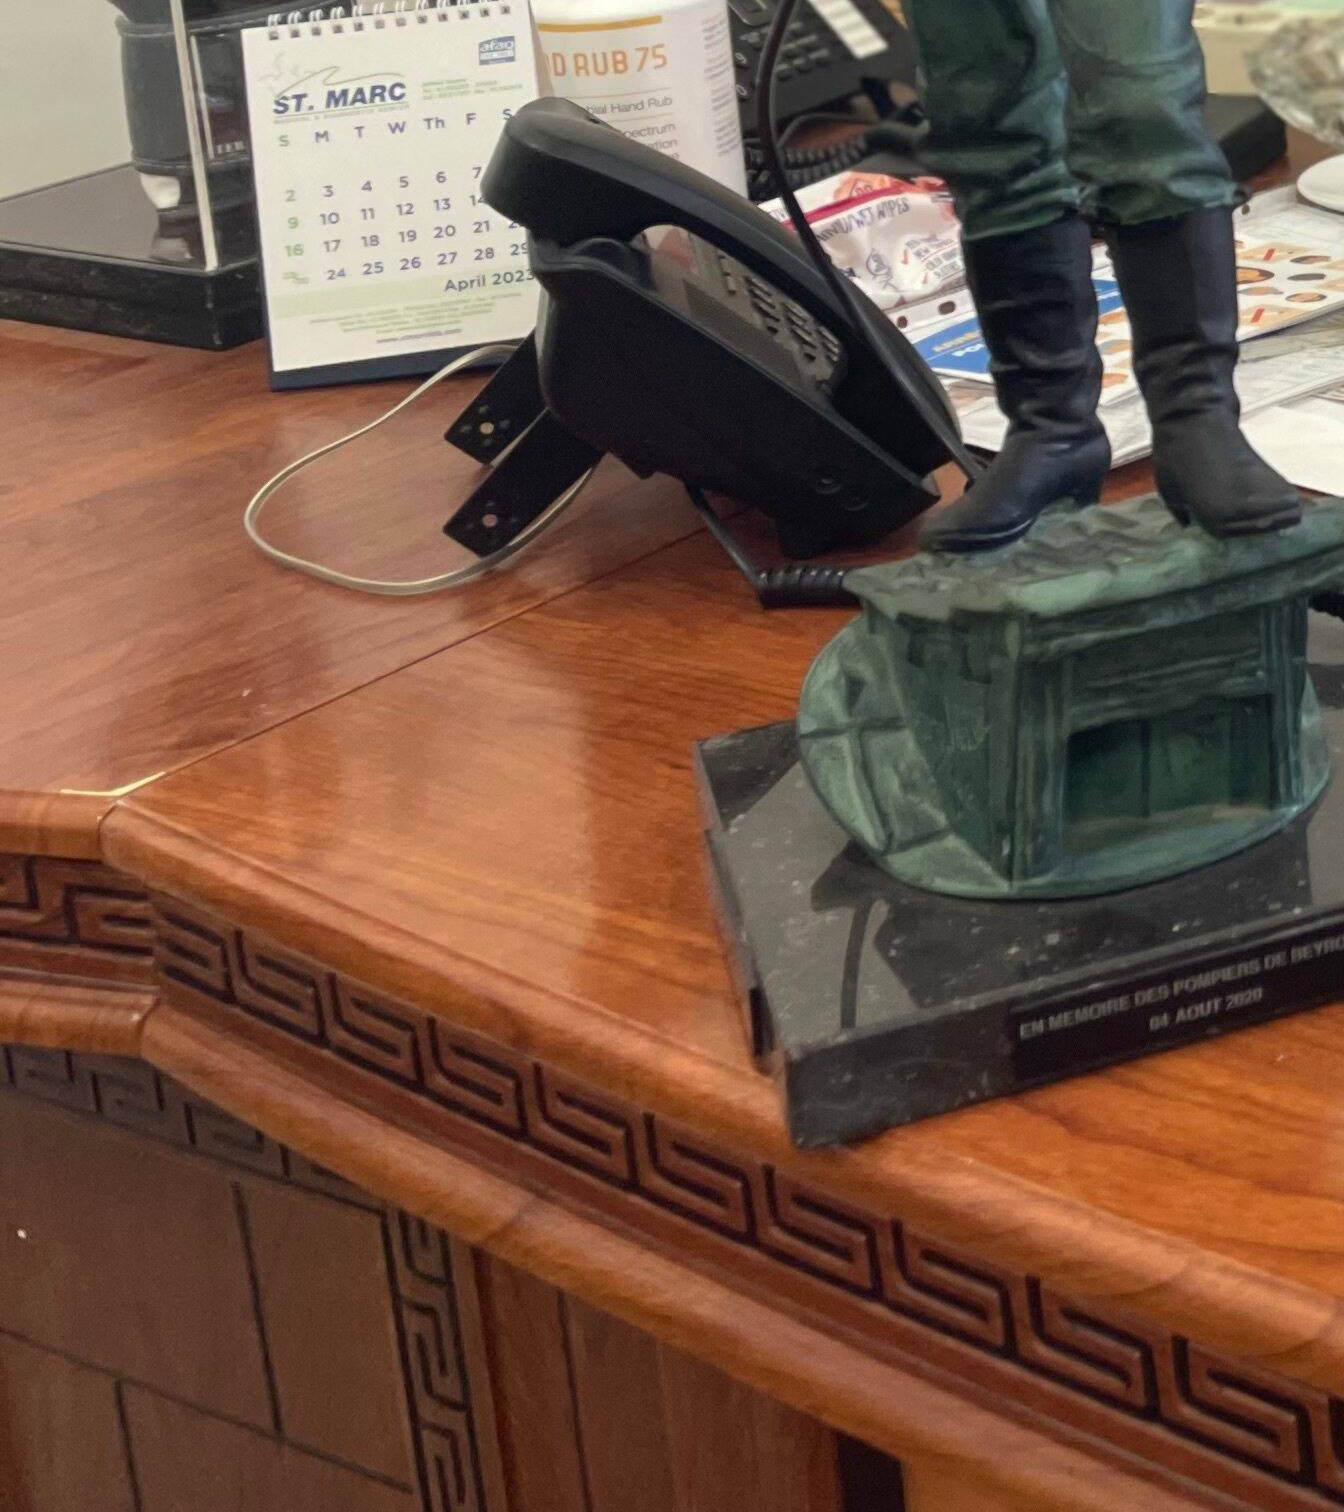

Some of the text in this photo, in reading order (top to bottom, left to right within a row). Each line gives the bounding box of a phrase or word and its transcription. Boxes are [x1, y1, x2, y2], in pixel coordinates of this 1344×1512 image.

[573, 50, 629, 77] RUB
[635, 44, 668, 72] 75
[273, 93, 315, 115] ST.
[325, 82, 408, 110] MARC
[610, 99, 645, 114] Hand
[647, 96, 673, 108] Rub
[314, 130, 330, 143] M
[354, 126, 365, 138] T
[387, 121, 406, 134] W
[423, 116, 446, 130] Th
[465, 112, 477, 125] F
[285, 166, 482, 202] 2 3 4 5 6 7
[287, 217, 299, 230] 9
[319, 212, 340, 225] 10
[360, 208, 375, 220] 11
[396, 203, 414, 216] 12
[433, 198, 451, 211] 13
[285, 244, 304, 257] 16
[324, 240, 341, 252] 17
[361, 235, 379, 248] 18
[399, 230, 417, 243] 19
[433, 225, 456, 239] 20
[473, 220, 490, 233] 21
[327, 268, 347, 281] 24
[362, 262, 384, 276] 25
[399, 257, 421, 271] 26
[437, 252, 458, 266] 27
[474, 247, 495, 261] 28
[444, 270, 536, 293] April 2023
[1019, 1020, 1045, 1040] EN
[1134, 983, 1170, 1008] DES
[1172, 959, 1264, 999] POMPIERS
[1264, 951, 1288, 972] DE
[1225, 987, 1264, 1013] 2020
